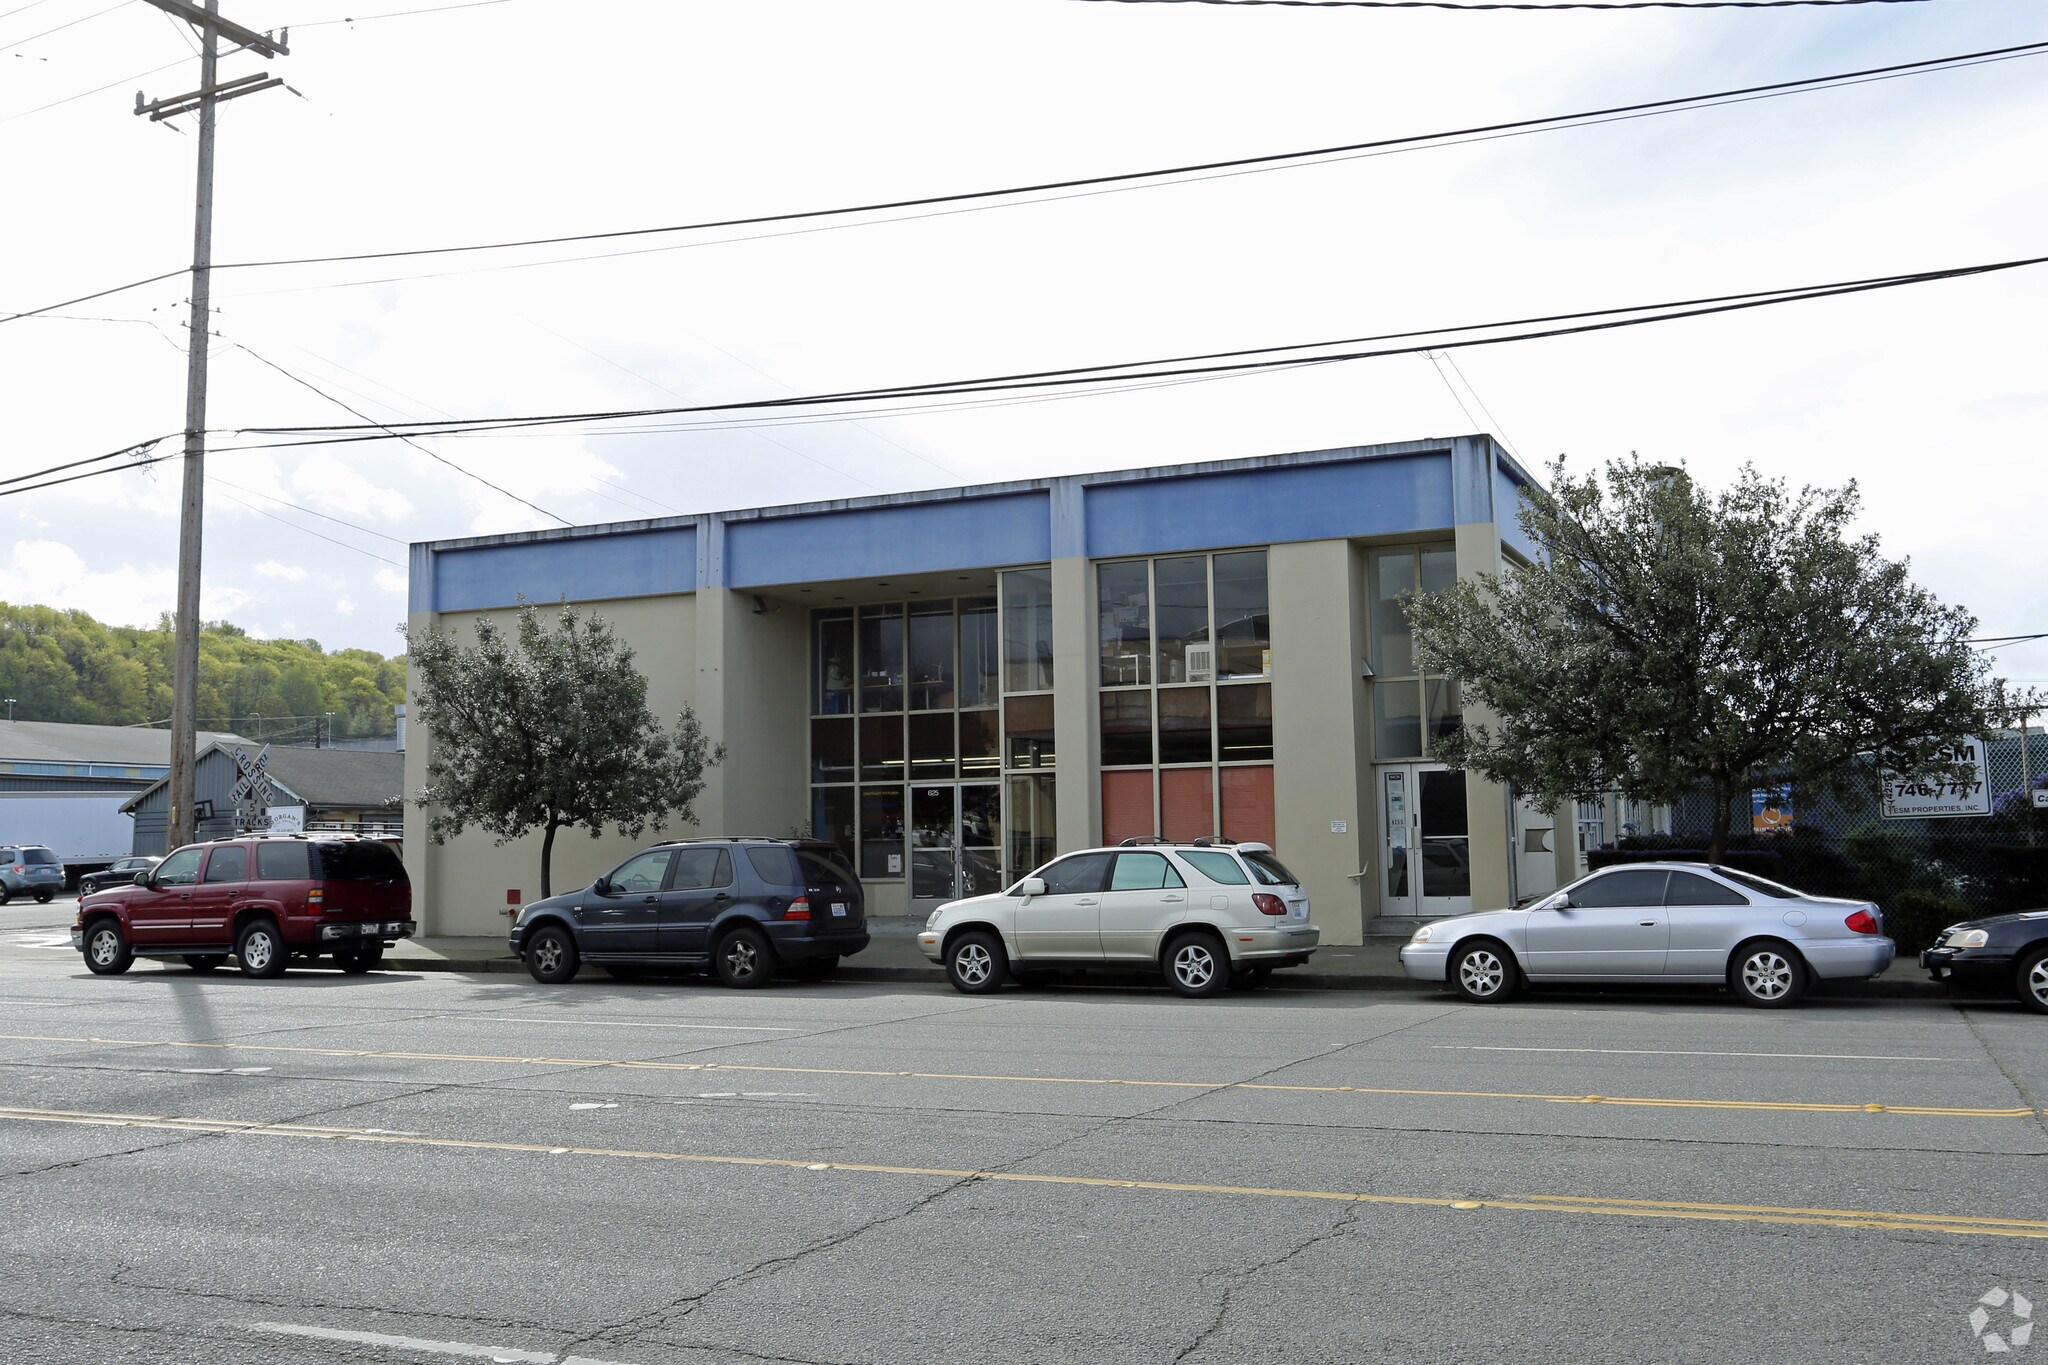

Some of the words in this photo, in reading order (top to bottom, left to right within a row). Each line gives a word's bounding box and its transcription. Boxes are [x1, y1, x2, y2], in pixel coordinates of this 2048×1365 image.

[235, 747, 273, 802] CROSSING
[1912, 805, 1963, 813] PROPERTIES,
[234, 818, 269, 826] TRACKS
